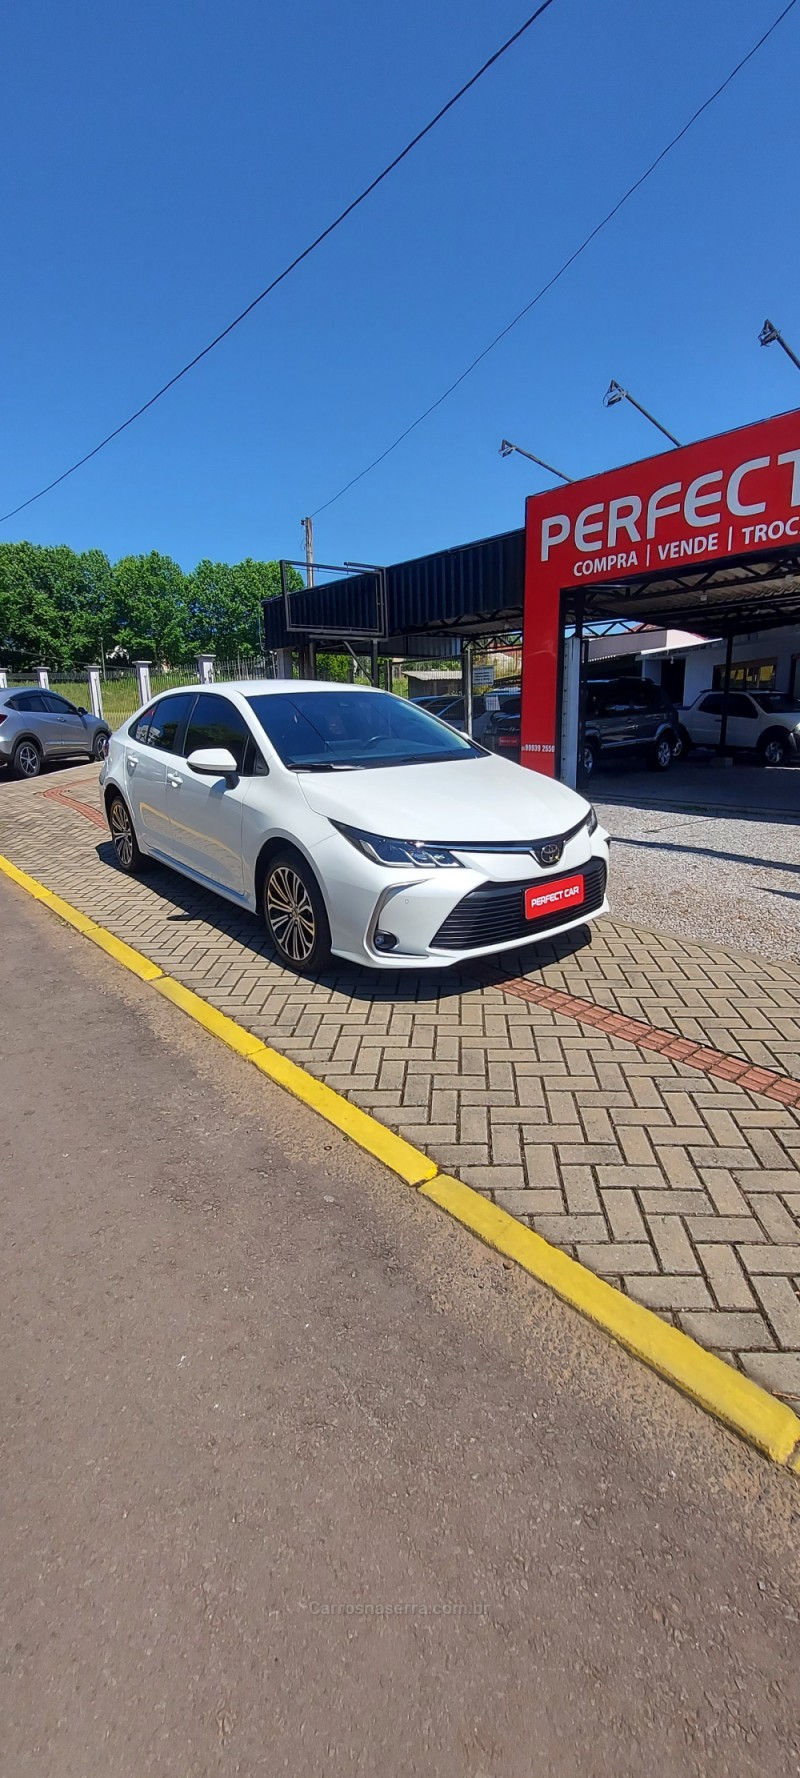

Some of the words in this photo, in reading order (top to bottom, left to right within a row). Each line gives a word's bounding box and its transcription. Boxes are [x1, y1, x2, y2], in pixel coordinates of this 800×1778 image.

[573, 551, 638, 577] COMPRA
[658, 533, 719, 561] VENDE
[741, 517, 800, 545] TROC
[531, 890, 564, 908] PERFECT
[564, 886, 580, 898] CAR
